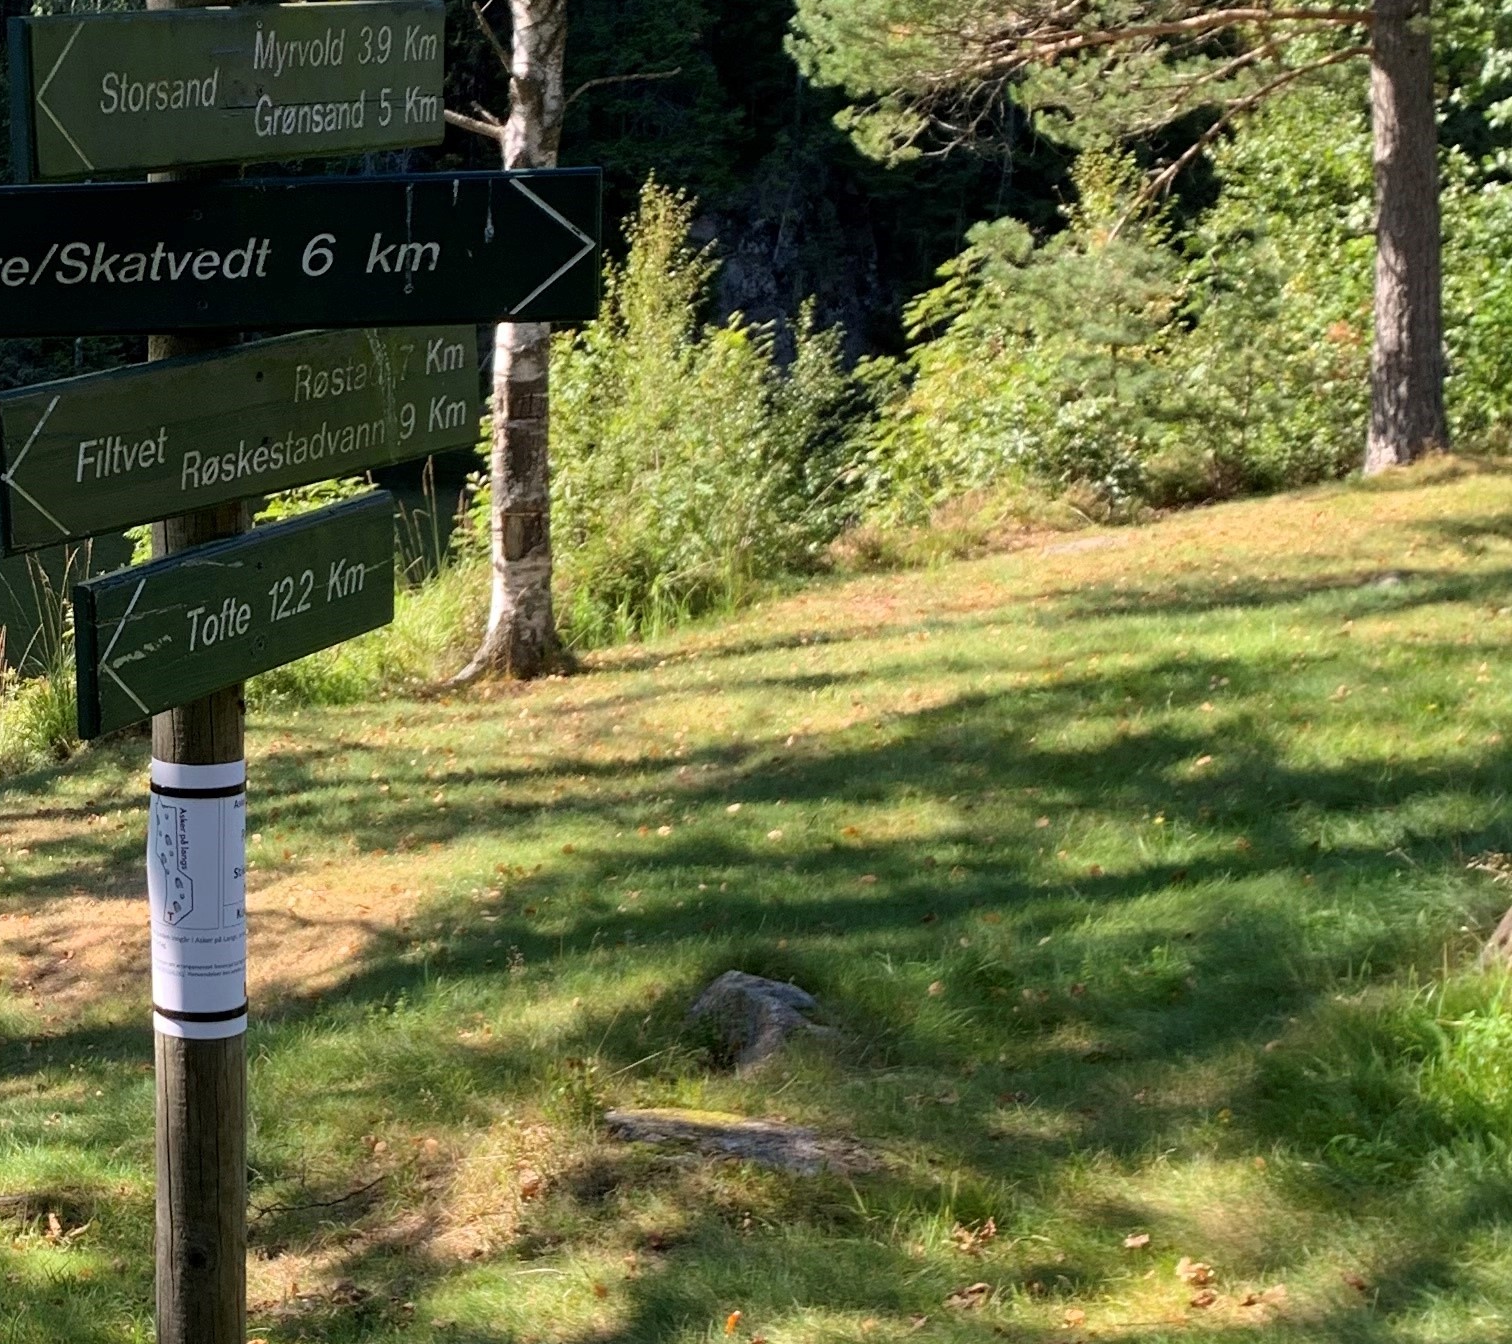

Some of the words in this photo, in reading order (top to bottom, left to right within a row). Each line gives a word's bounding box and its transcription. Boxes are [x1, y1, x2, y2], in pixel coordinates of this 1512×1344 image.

[254, 26, 344, 77] Myrvold
[359, 26, 392, 64] 3.9
[404, 25, 437, 62] Km
[100, 67, 219, 115] Storsand
[255, 90, 365, 137] Grønsand
[378, 90, 392, 128] 5
[405, 87, 438, 124] Km
[302, 233, 337, 277] 6
[366, 232, 441, 274] km
[426, 338, 464, 375] Km
[76, 426, 168, 483] Filtvet
[181, 416, 386, 490] Røskestadvann
[428, 395, 466, 432] Km
[187, 597, 252, 651] Tofte
[268, 569, 314, 622] 12.2
[327, 558, 365, 602] Km
